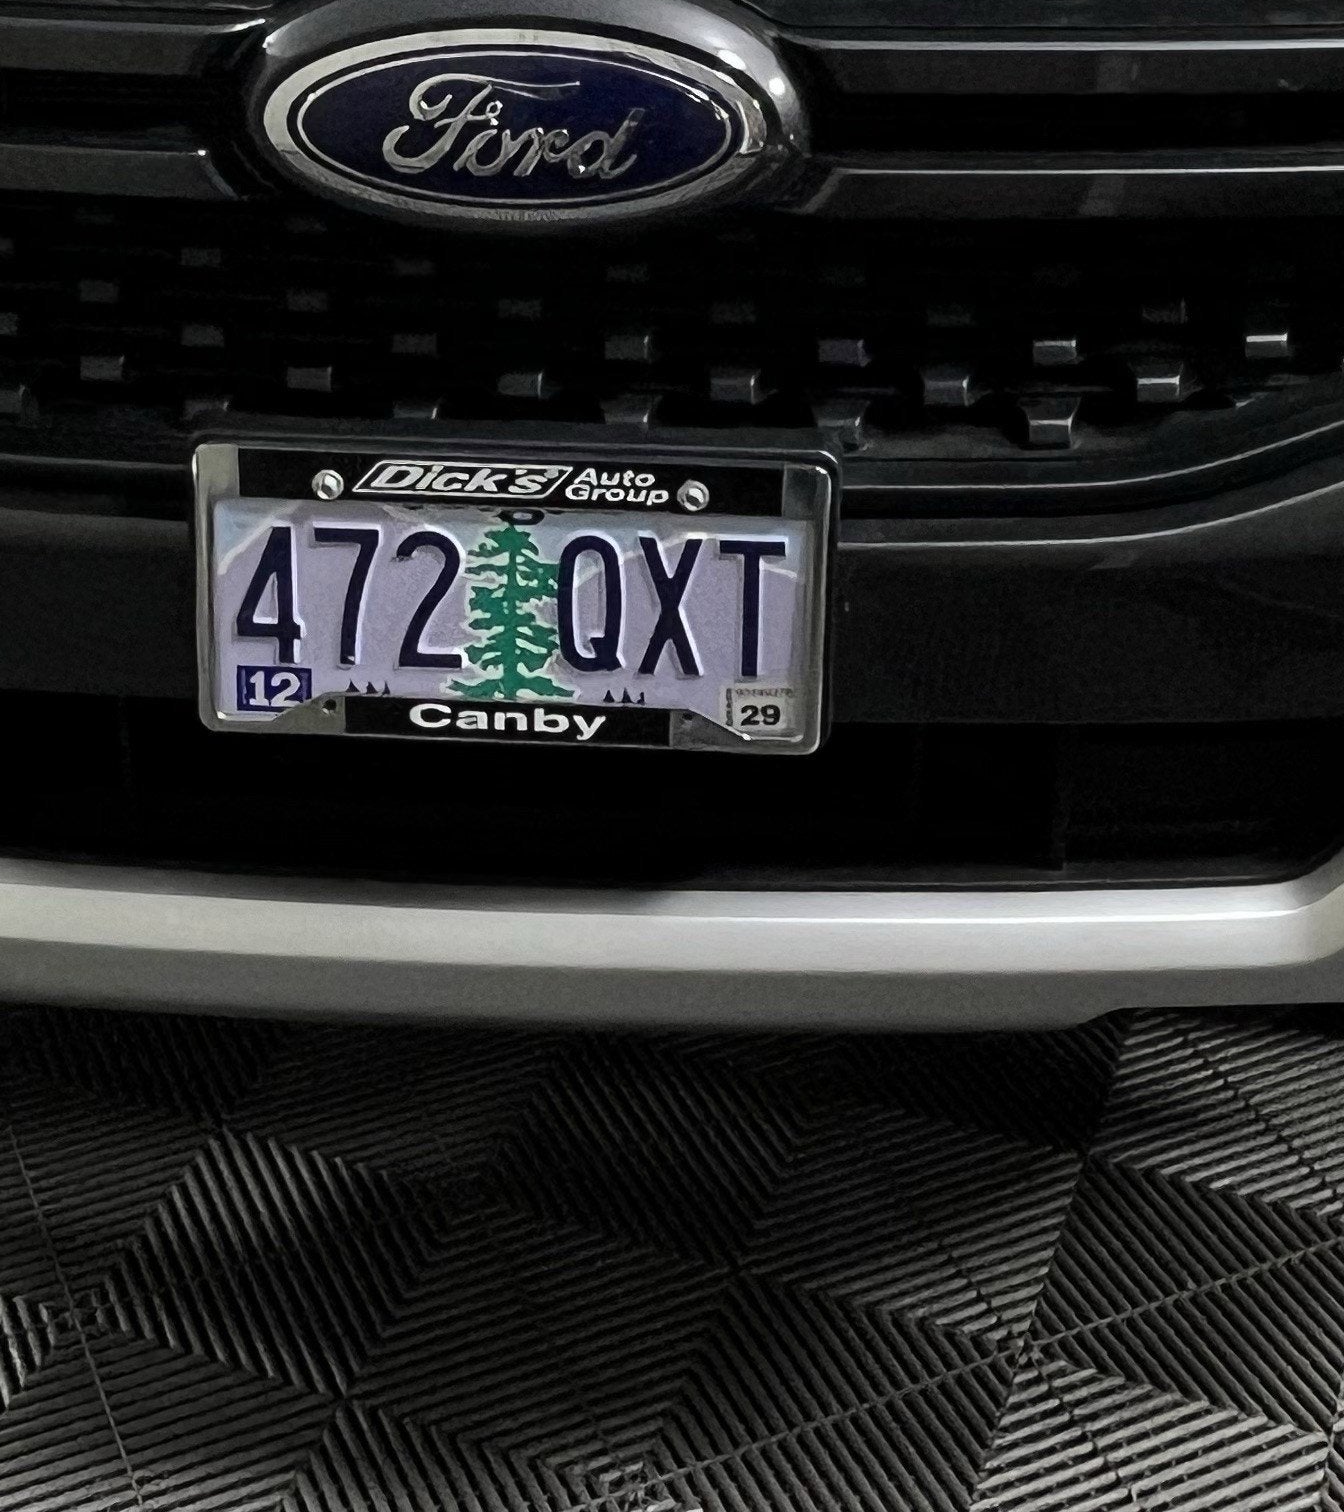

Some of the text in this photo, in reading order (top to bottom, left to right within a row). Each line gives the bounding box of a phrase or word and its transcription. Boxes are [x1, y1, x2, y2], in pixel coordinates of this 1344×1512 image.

[382, 73, 645, 179] Ford
[370, 464, 549, 494] Dick's
[565, 483, 670, 505] Group
[575, 467, 655, 487] Auto
[235, 525, 787, 678] 472 QXT
[249, 670, 301, 708] 12
[409, 702, 606, 740] Canby
[740, 704, 781, 726] 29
